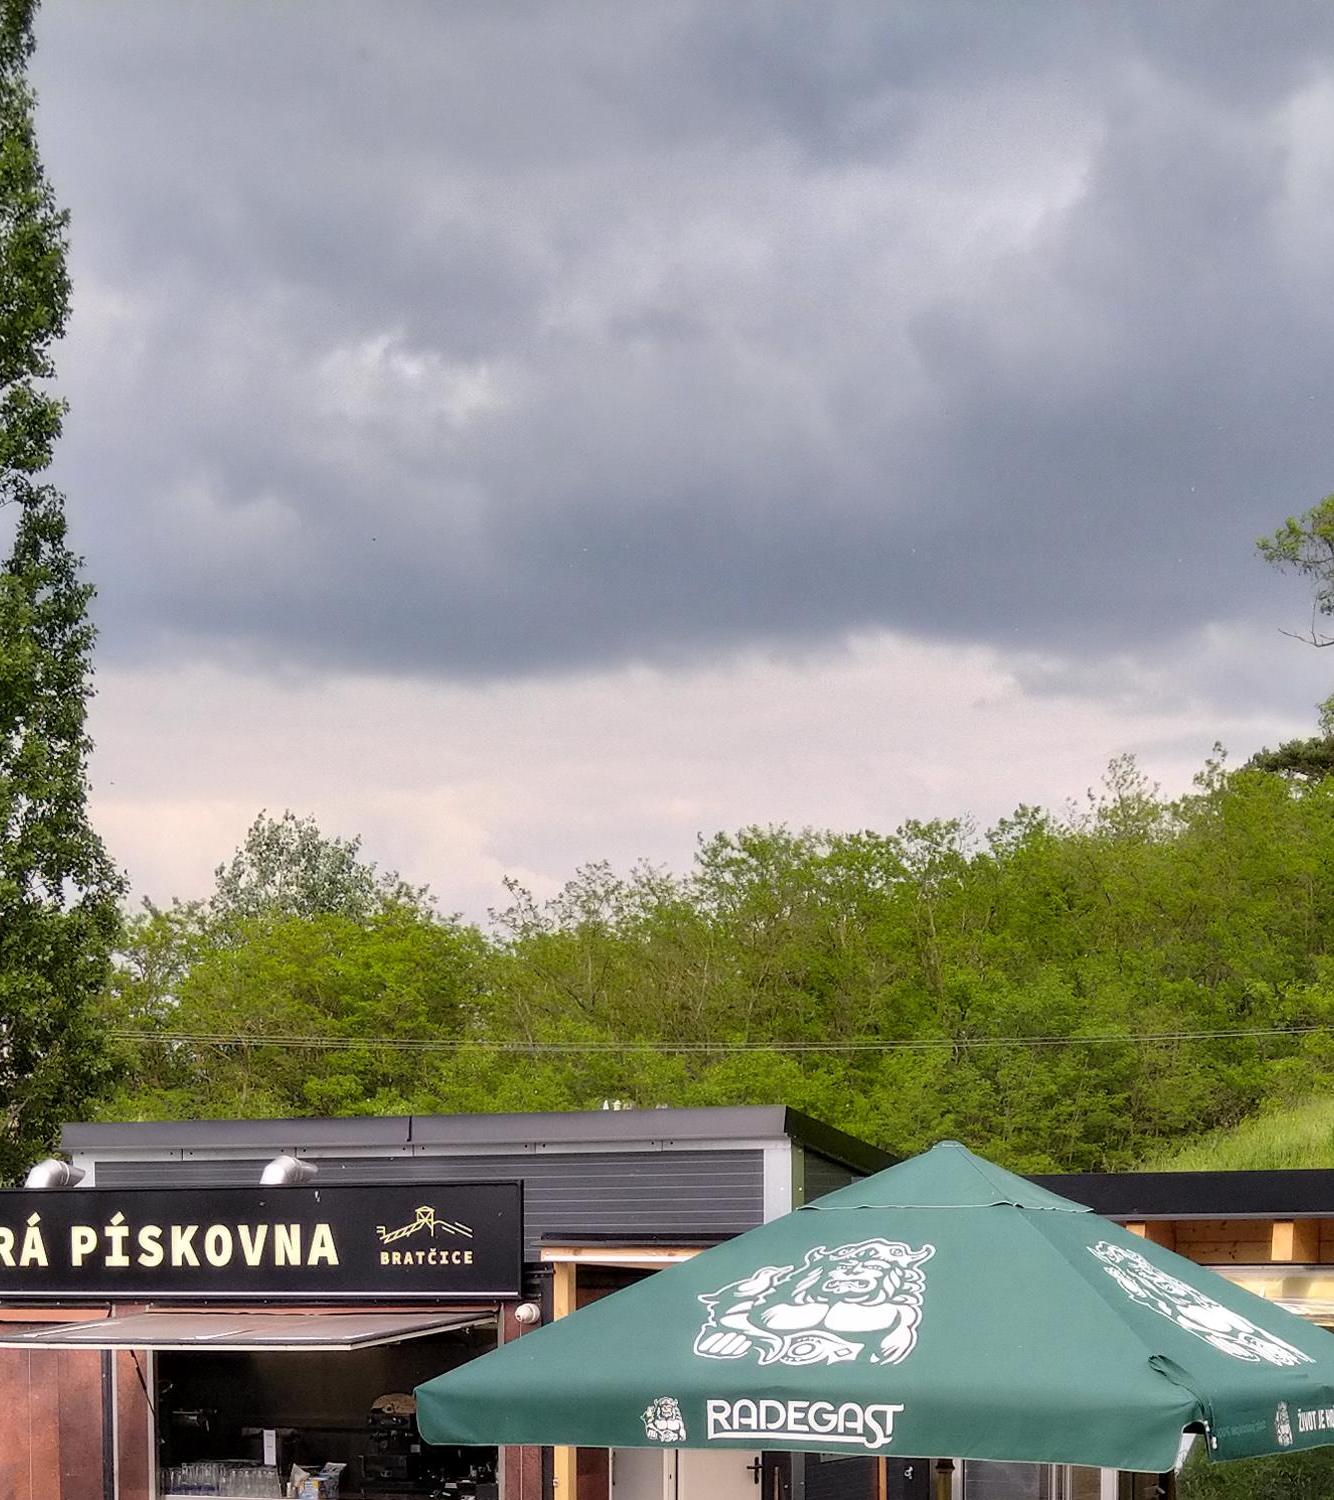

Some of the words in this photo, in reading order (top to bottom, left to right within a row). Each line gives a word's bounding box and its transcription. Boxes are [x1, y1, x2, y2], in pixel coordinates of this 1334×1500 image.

[70, 1210, 340, 1268] PÍSKOVNA
[379, 1247, 474, 1266] BRATČICE
[706, 1398, 905, 1449] RADEGAST
